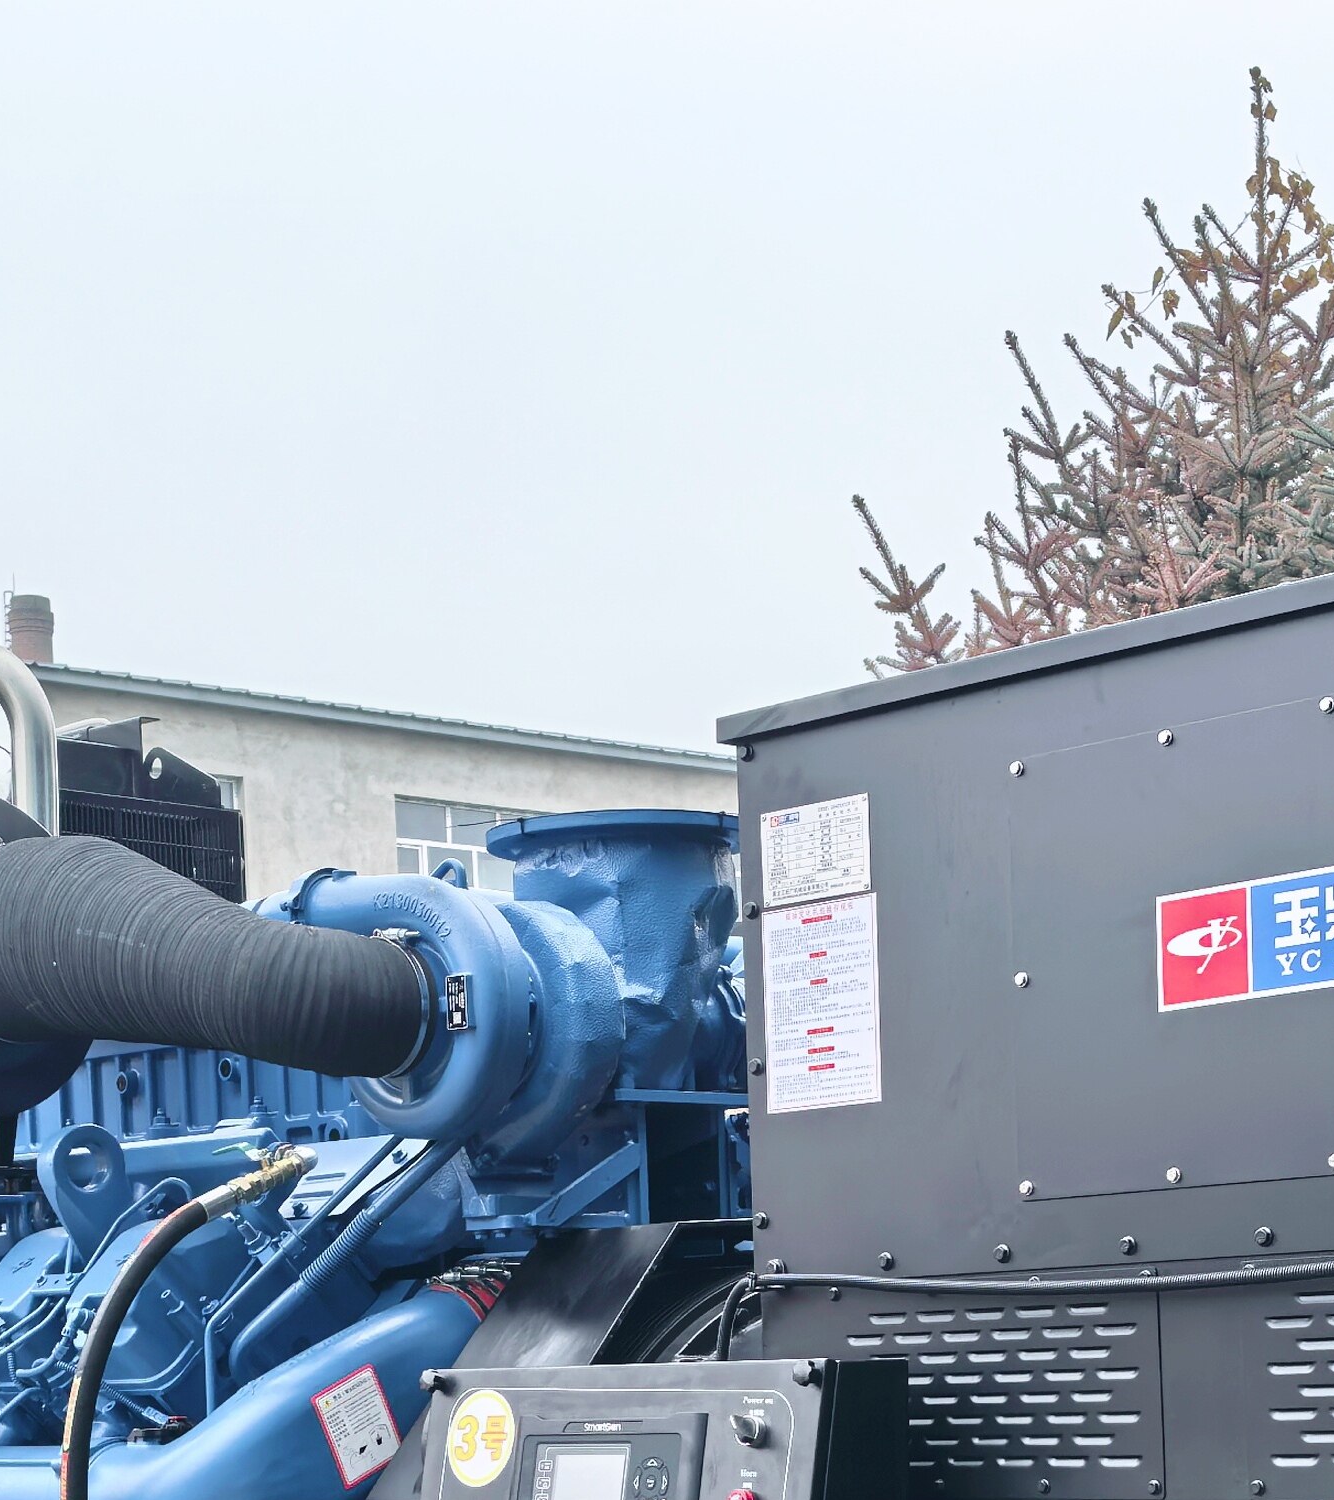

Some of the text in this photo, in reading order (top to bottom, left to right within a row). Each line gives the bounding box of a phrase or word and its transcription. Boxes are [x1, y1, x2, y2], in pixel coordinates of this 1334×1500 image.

[1275, 948, 1322, 976] YC
[454, 1414, 508, 1462] 3号
[584, 1422, 622, 1432] SmartGen
